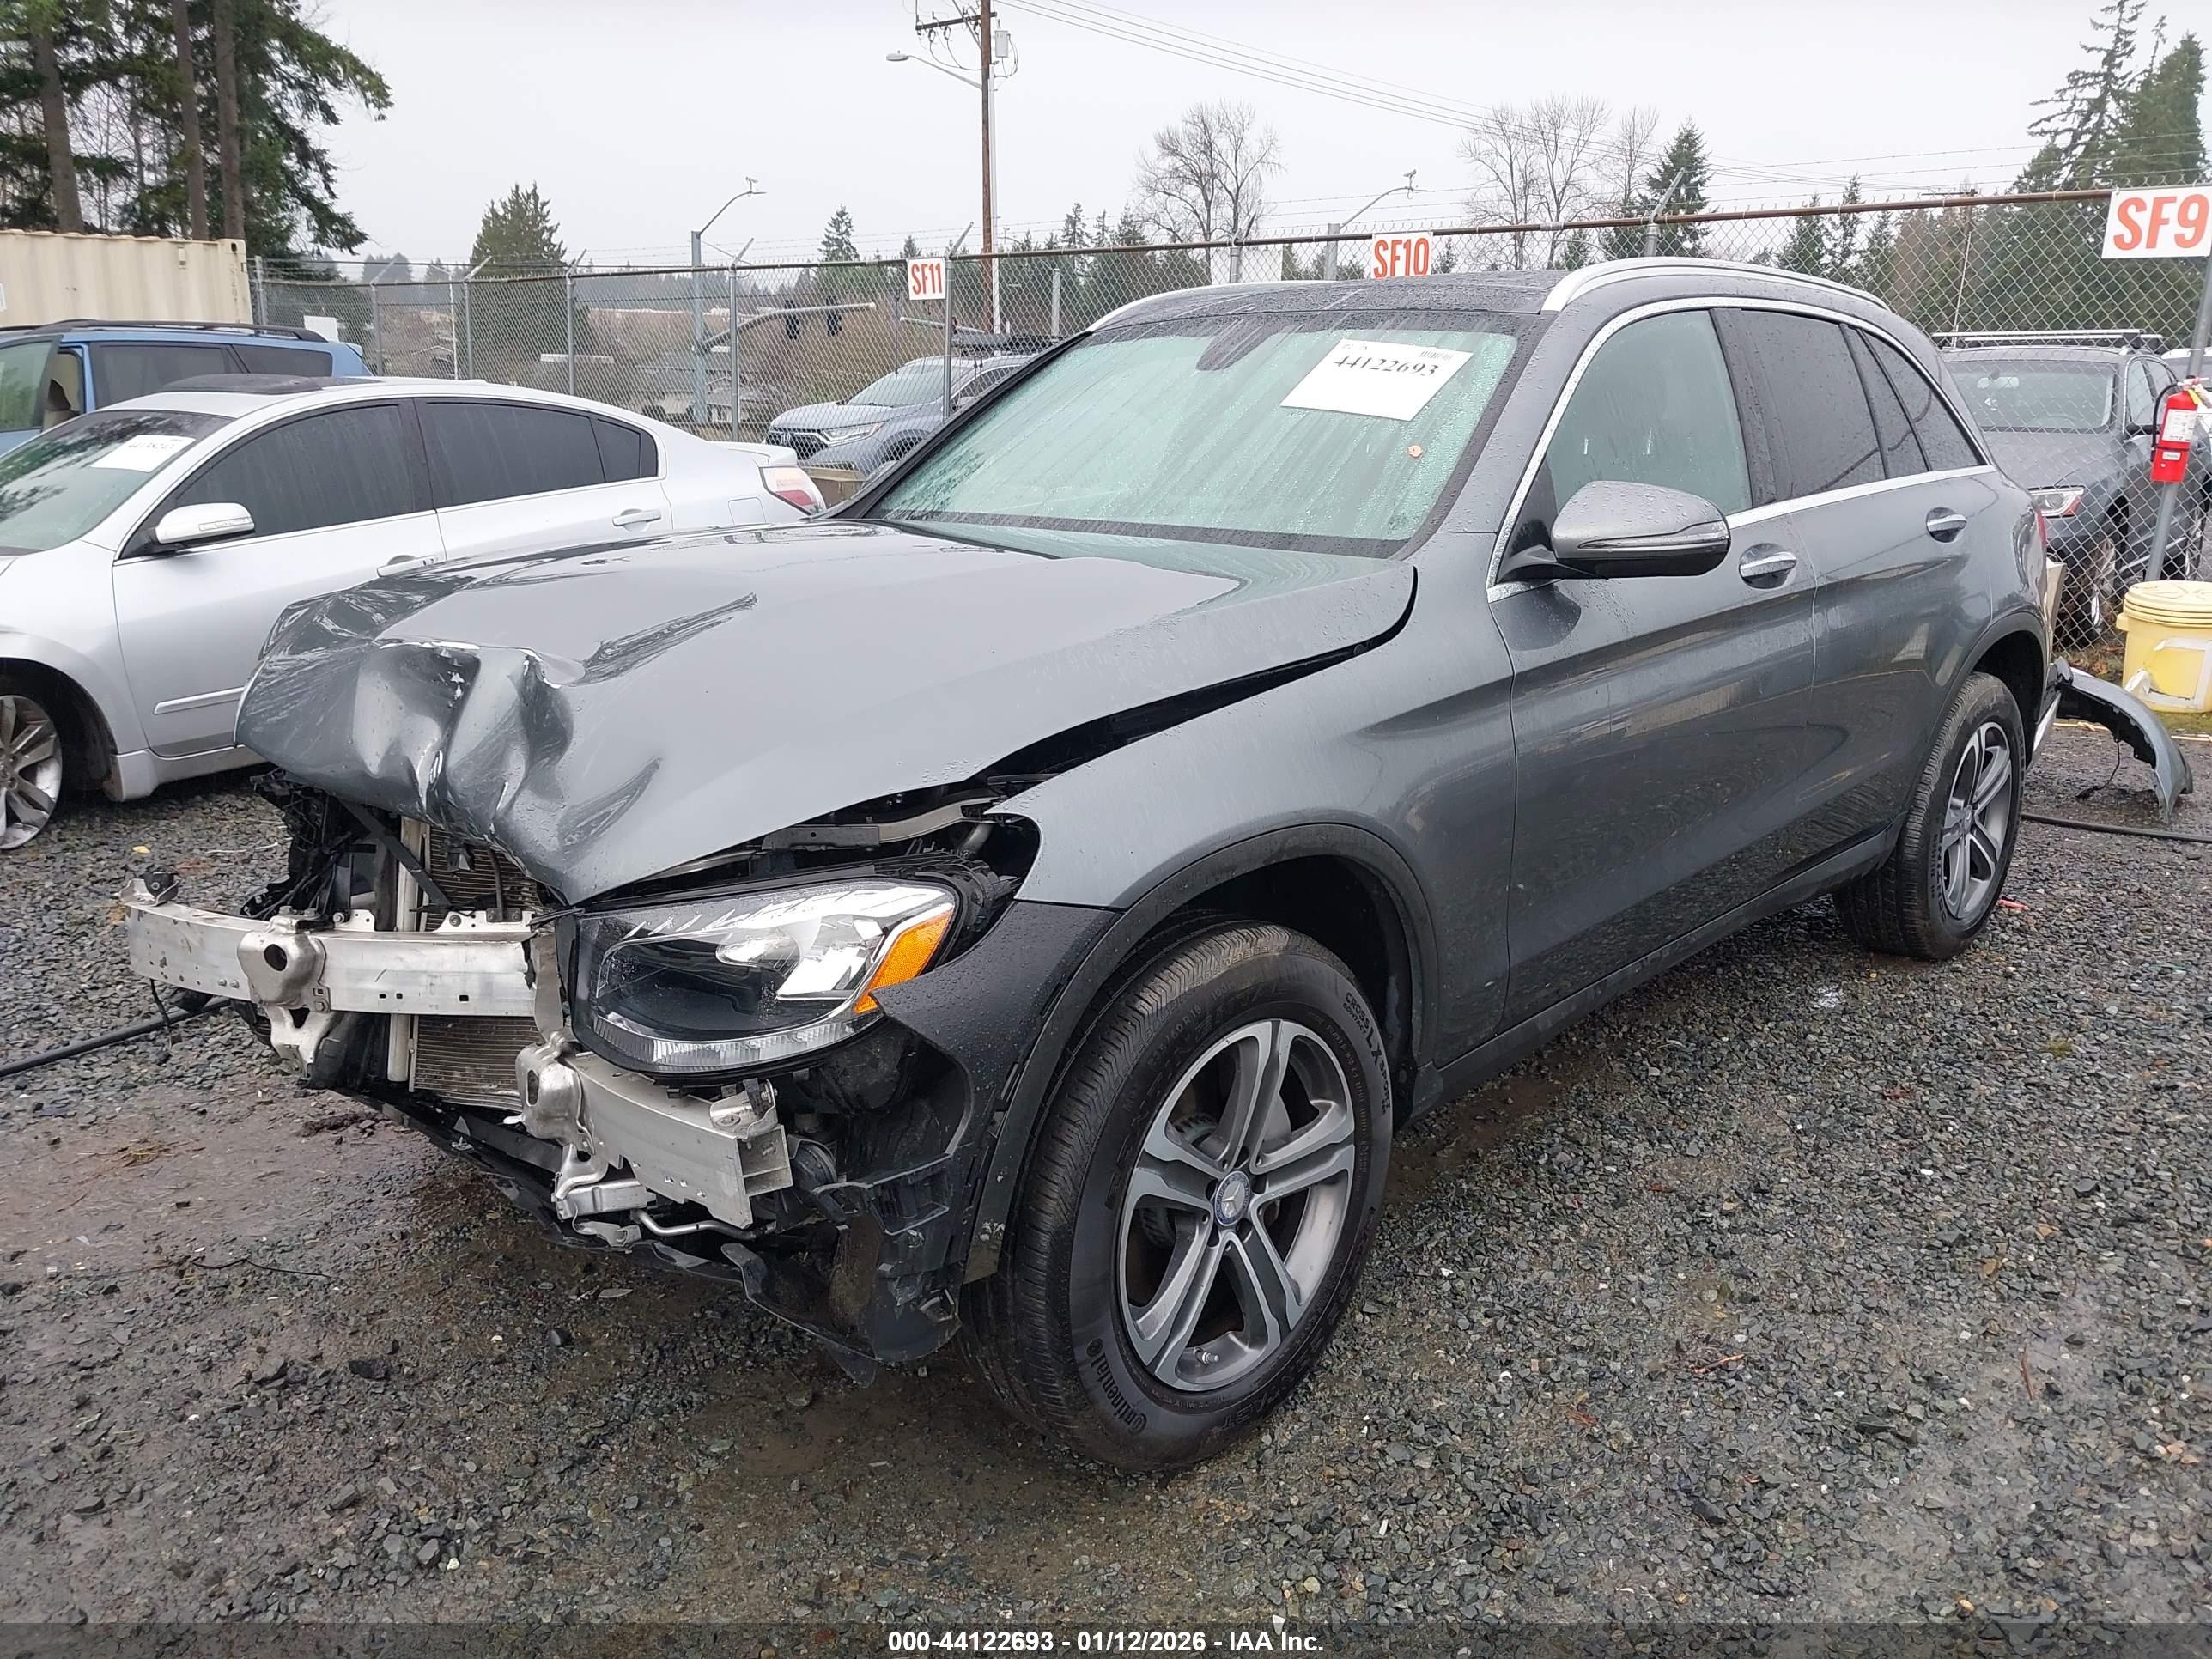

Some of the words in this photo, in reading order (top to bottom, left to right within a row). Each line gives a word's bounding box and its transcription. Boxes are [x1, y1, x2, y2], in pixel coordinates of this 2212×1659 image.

[2113, 194, 2210, 251] SF9
[1374, 237, 1430, 278] SF10
[911, 262, 943, 295] SF11
[1334, 355, 1439, 376] 44122693
[1346, 992, 1370, 1029] CROSS
